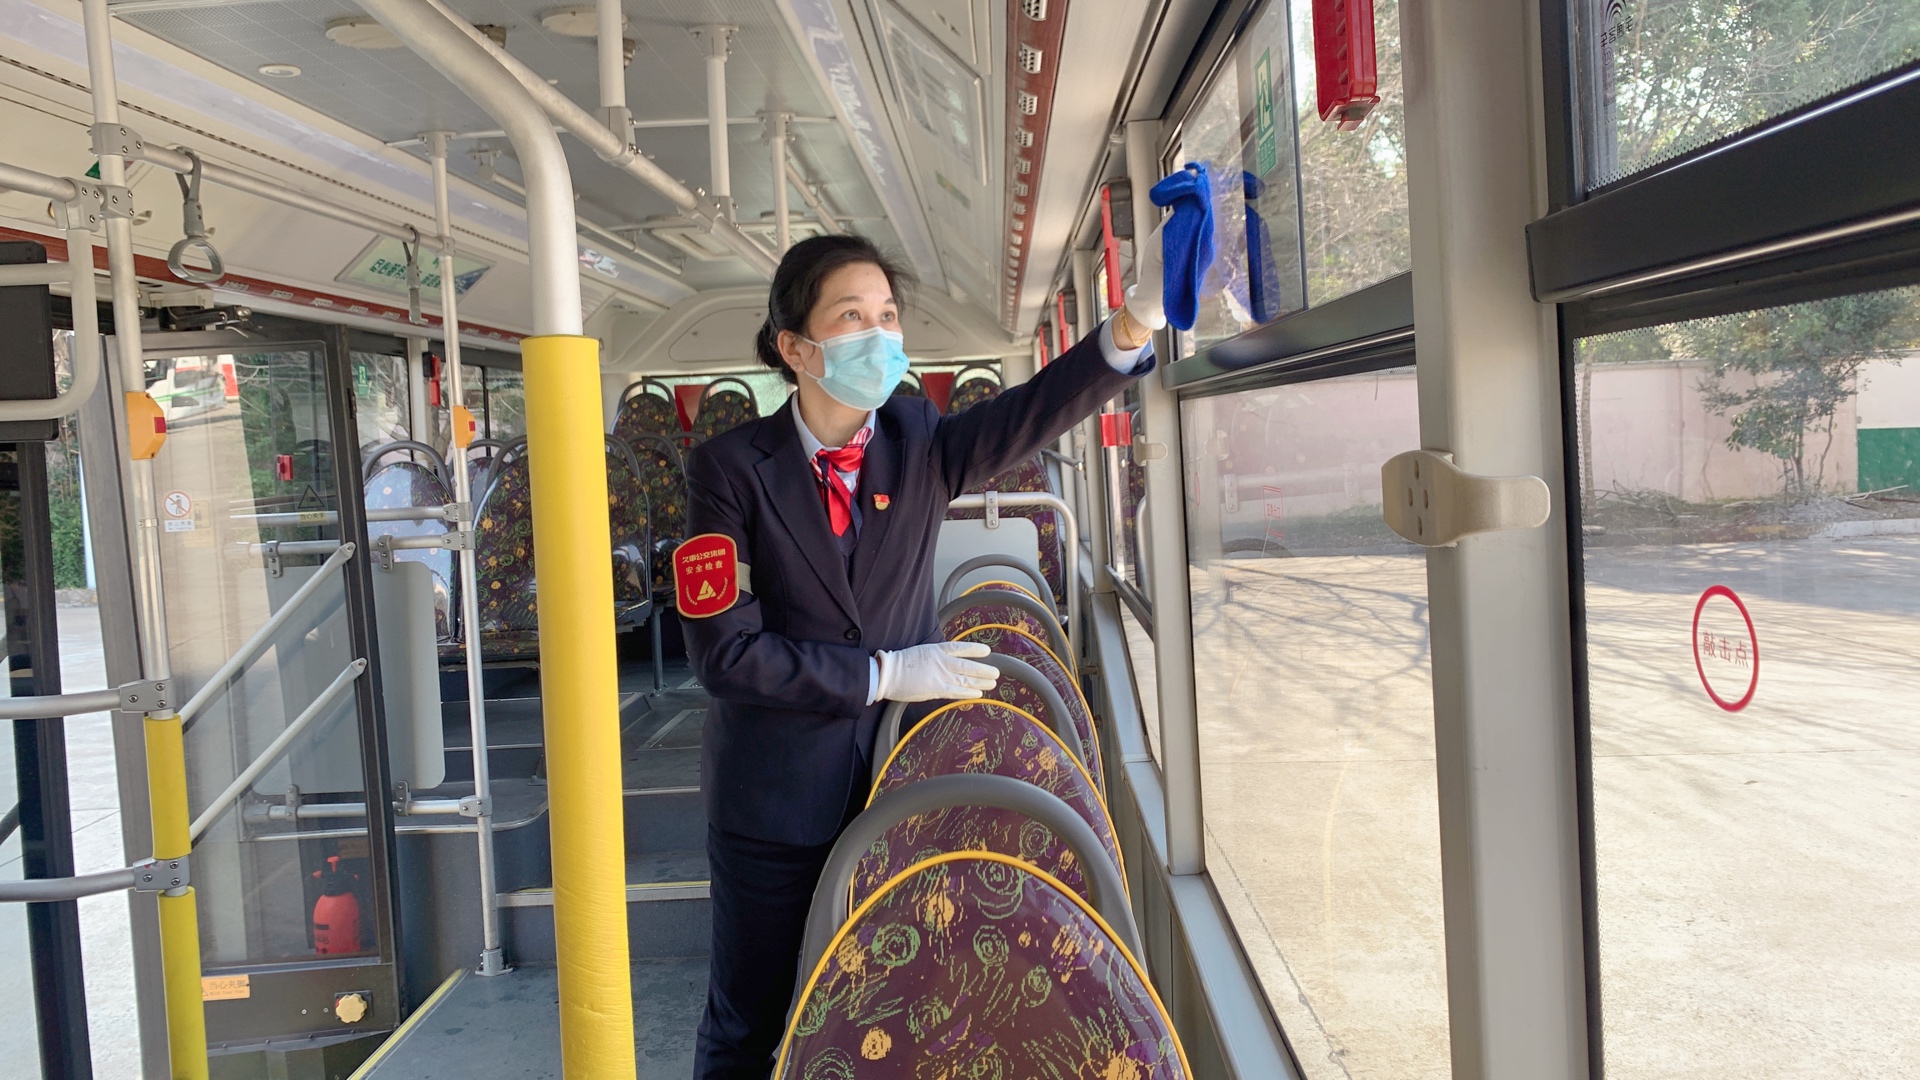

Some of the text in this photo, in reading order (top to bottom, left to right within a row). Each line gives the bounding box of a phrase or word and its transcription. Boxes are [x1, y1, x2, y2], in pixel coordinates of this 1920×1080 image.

[685, 560, 723, 575] 安全检查
[1702, 631, 1749, 668] 敲击点
